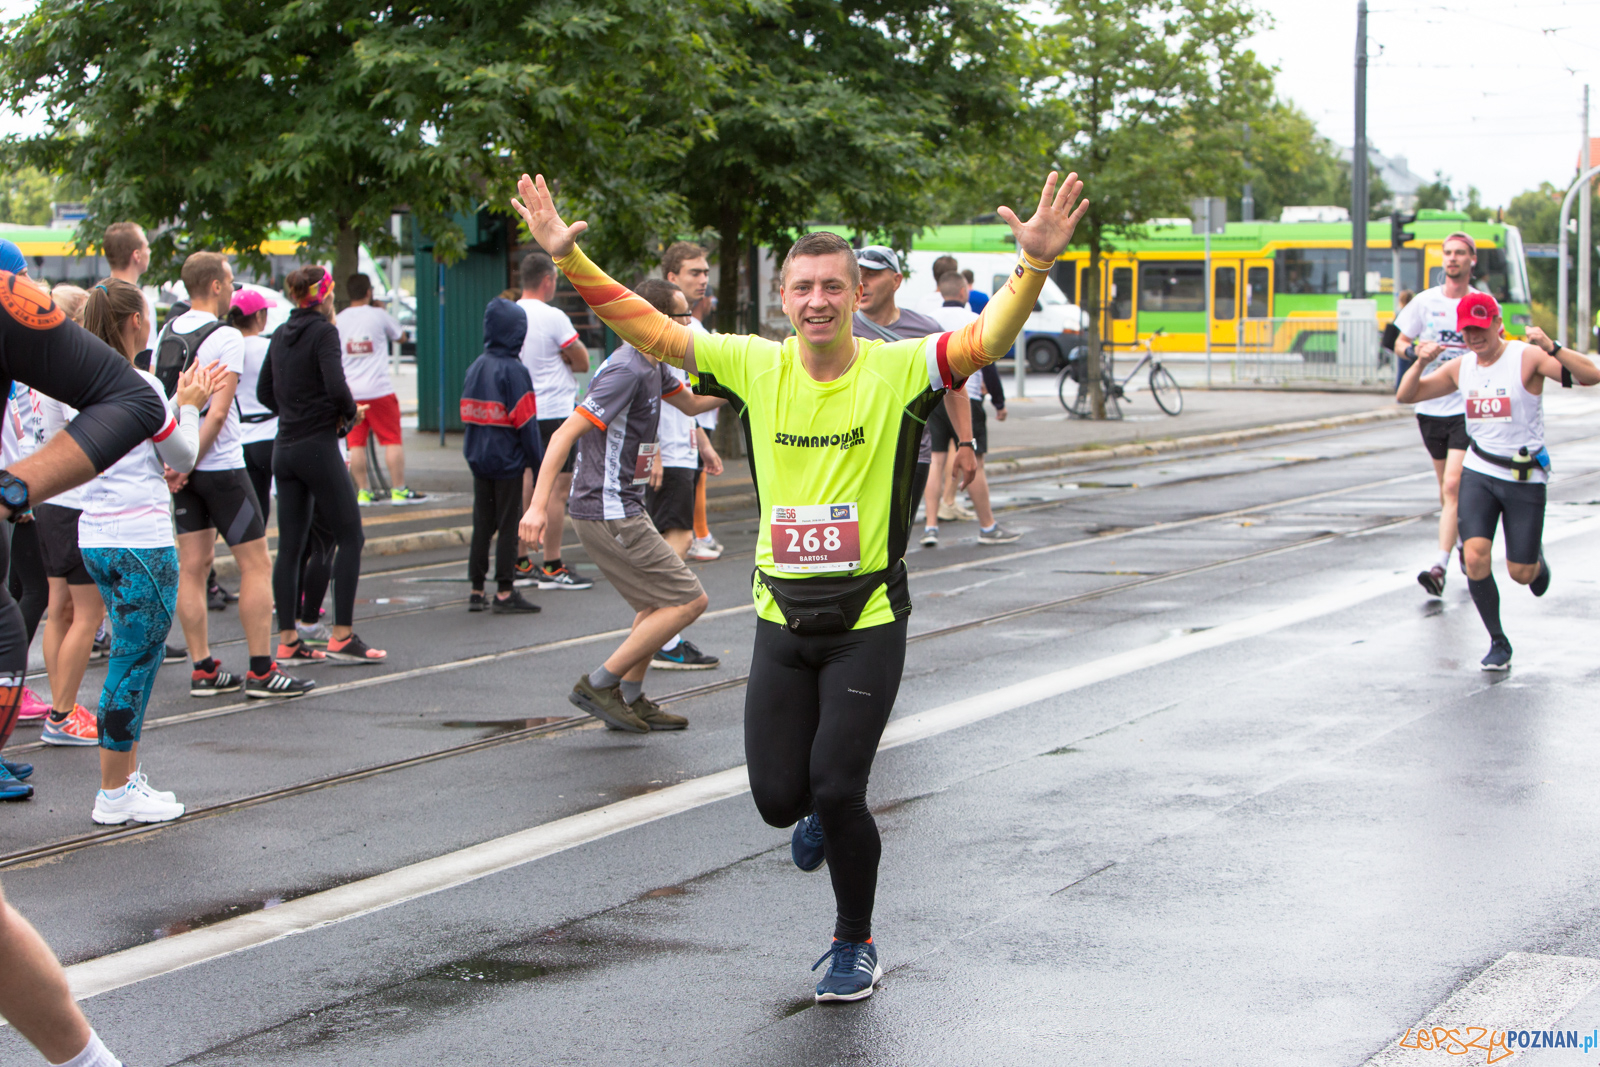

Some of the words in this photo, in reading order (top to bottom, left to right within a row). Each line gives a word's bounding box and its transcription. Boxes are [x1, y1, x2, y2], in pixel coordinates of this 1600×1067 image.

[1472, 398, 1502, 414] 760
[785, 526, 841, 552] 268
[799, 554, 828, 562] BARTOSZ
